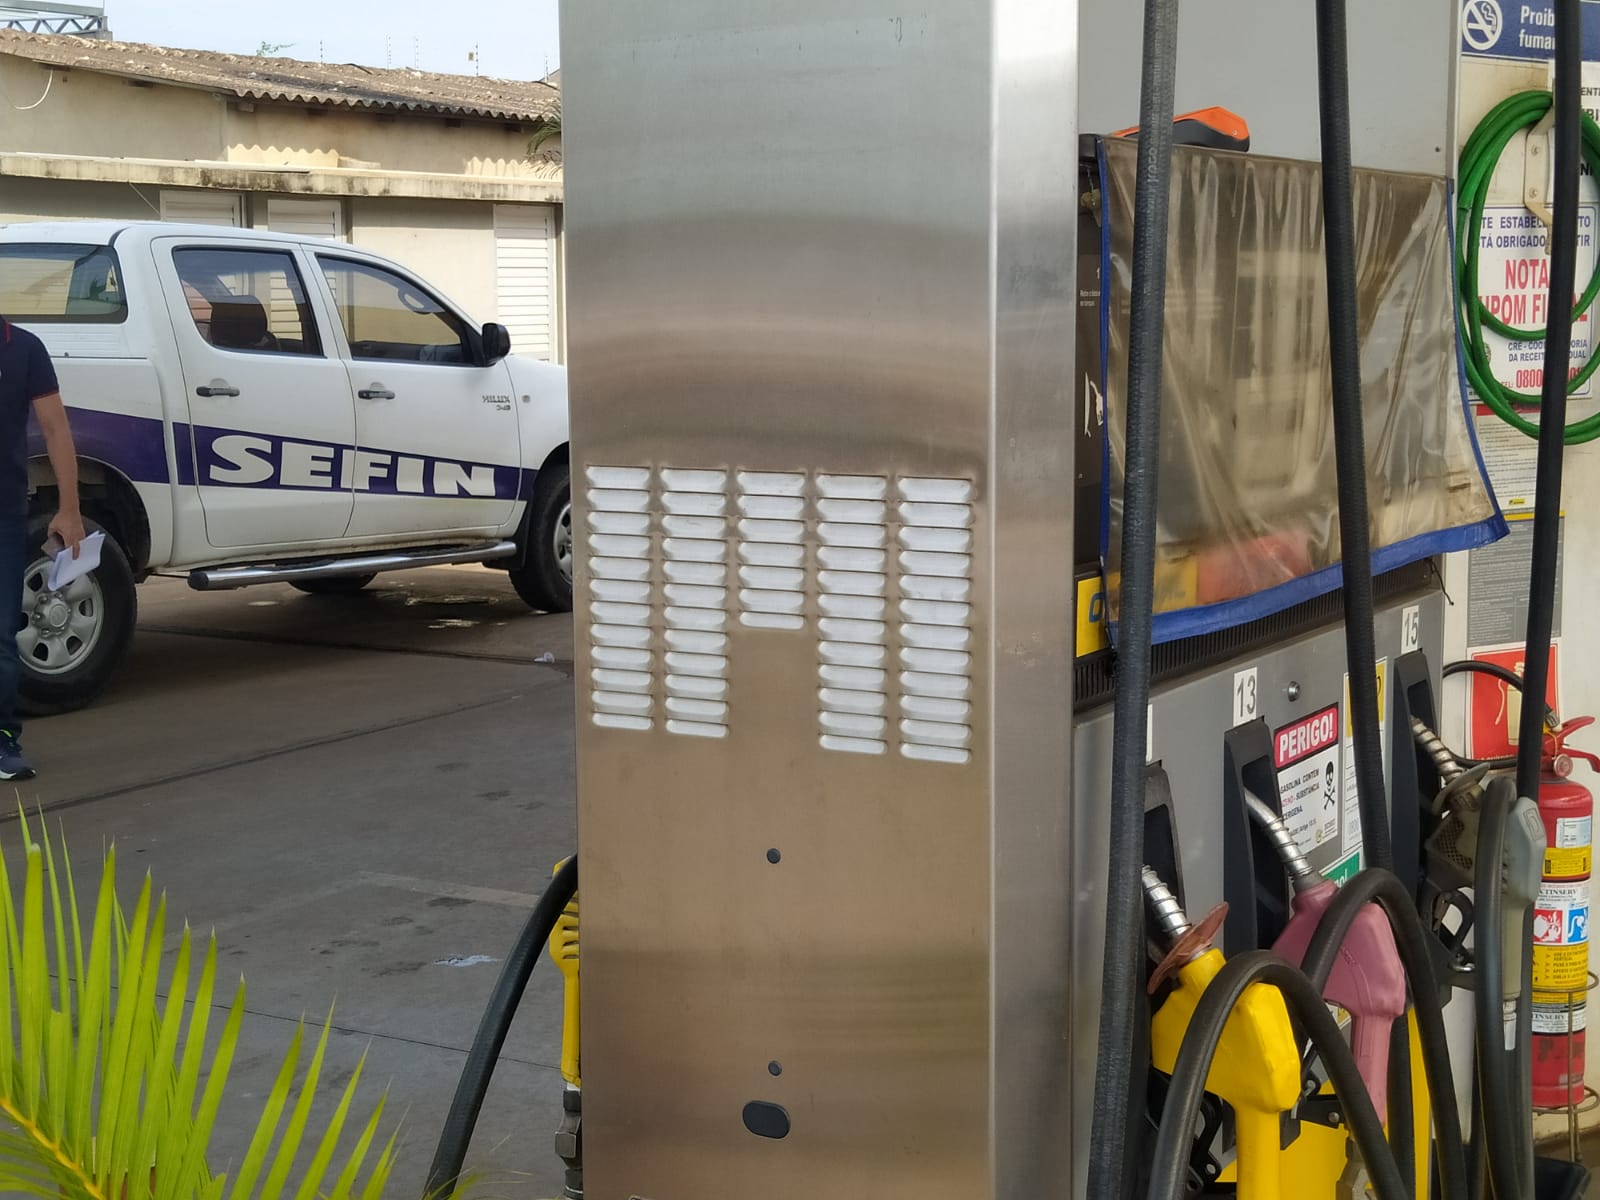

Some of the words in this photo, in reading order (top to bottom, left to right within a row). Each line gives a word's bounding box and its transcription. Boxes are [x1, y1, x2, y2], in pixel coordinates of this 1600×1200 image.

[1520, 5, 1555, 28] Proib
[1481, 216, 1493, 229] TE
[1480, 232, 1493, 248] TÁ
[1496, 235, 1546, 248] OBRIGADO
[1505, 259, 1549, 289] NOTA
[1508, 342, 1522, 351] CRE
[1509, 353, 1518, 362] DA
[1520, 352, 1545, 361] RECEIT
[209, 435, 496, 497] SEFIN
[1404, 612, 1418, 647] 15
[1237, 675, 1256, 717] 13
[1279, 712, 1333, 762] PERIGO!
